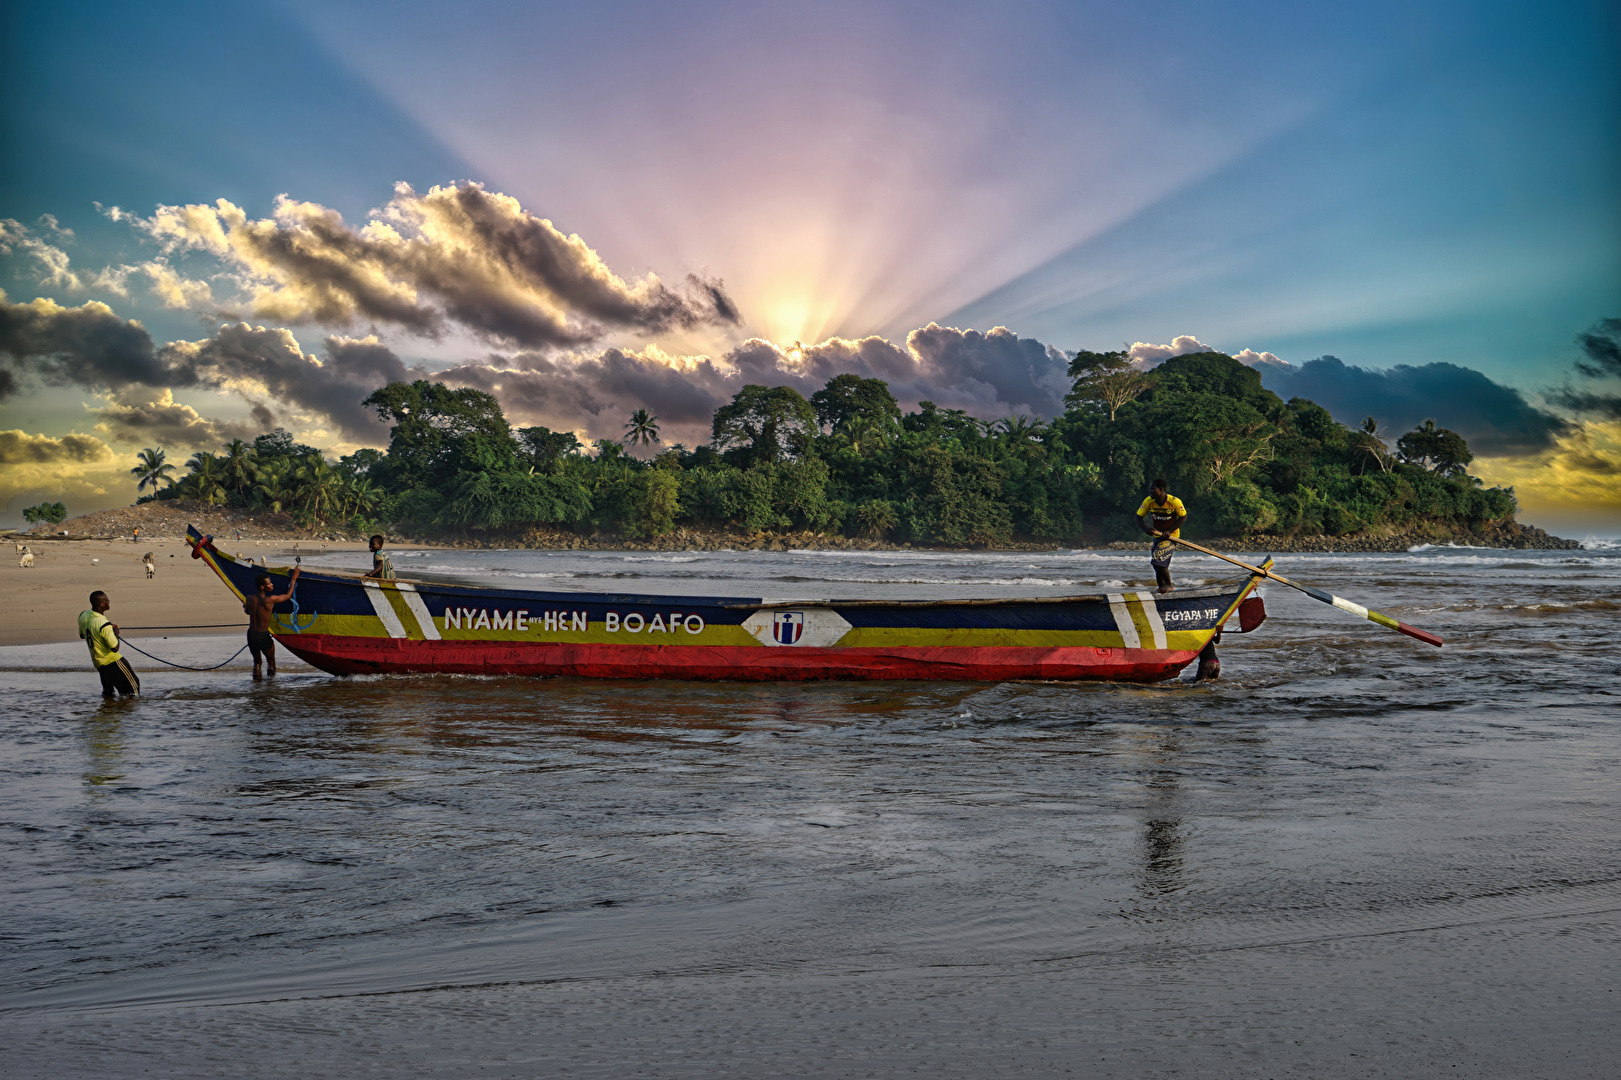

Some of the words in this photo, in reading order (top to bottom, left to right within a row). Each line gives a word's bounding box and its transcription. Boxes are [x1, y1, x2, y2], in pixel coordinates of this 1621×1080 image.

[444, 607, 530, 631] NYAME
[605, 611, 705, 635] BOAFO
[1164, 610, 1202, 621] EGYAPA
[1204, 608, 1219, 620] YIE
